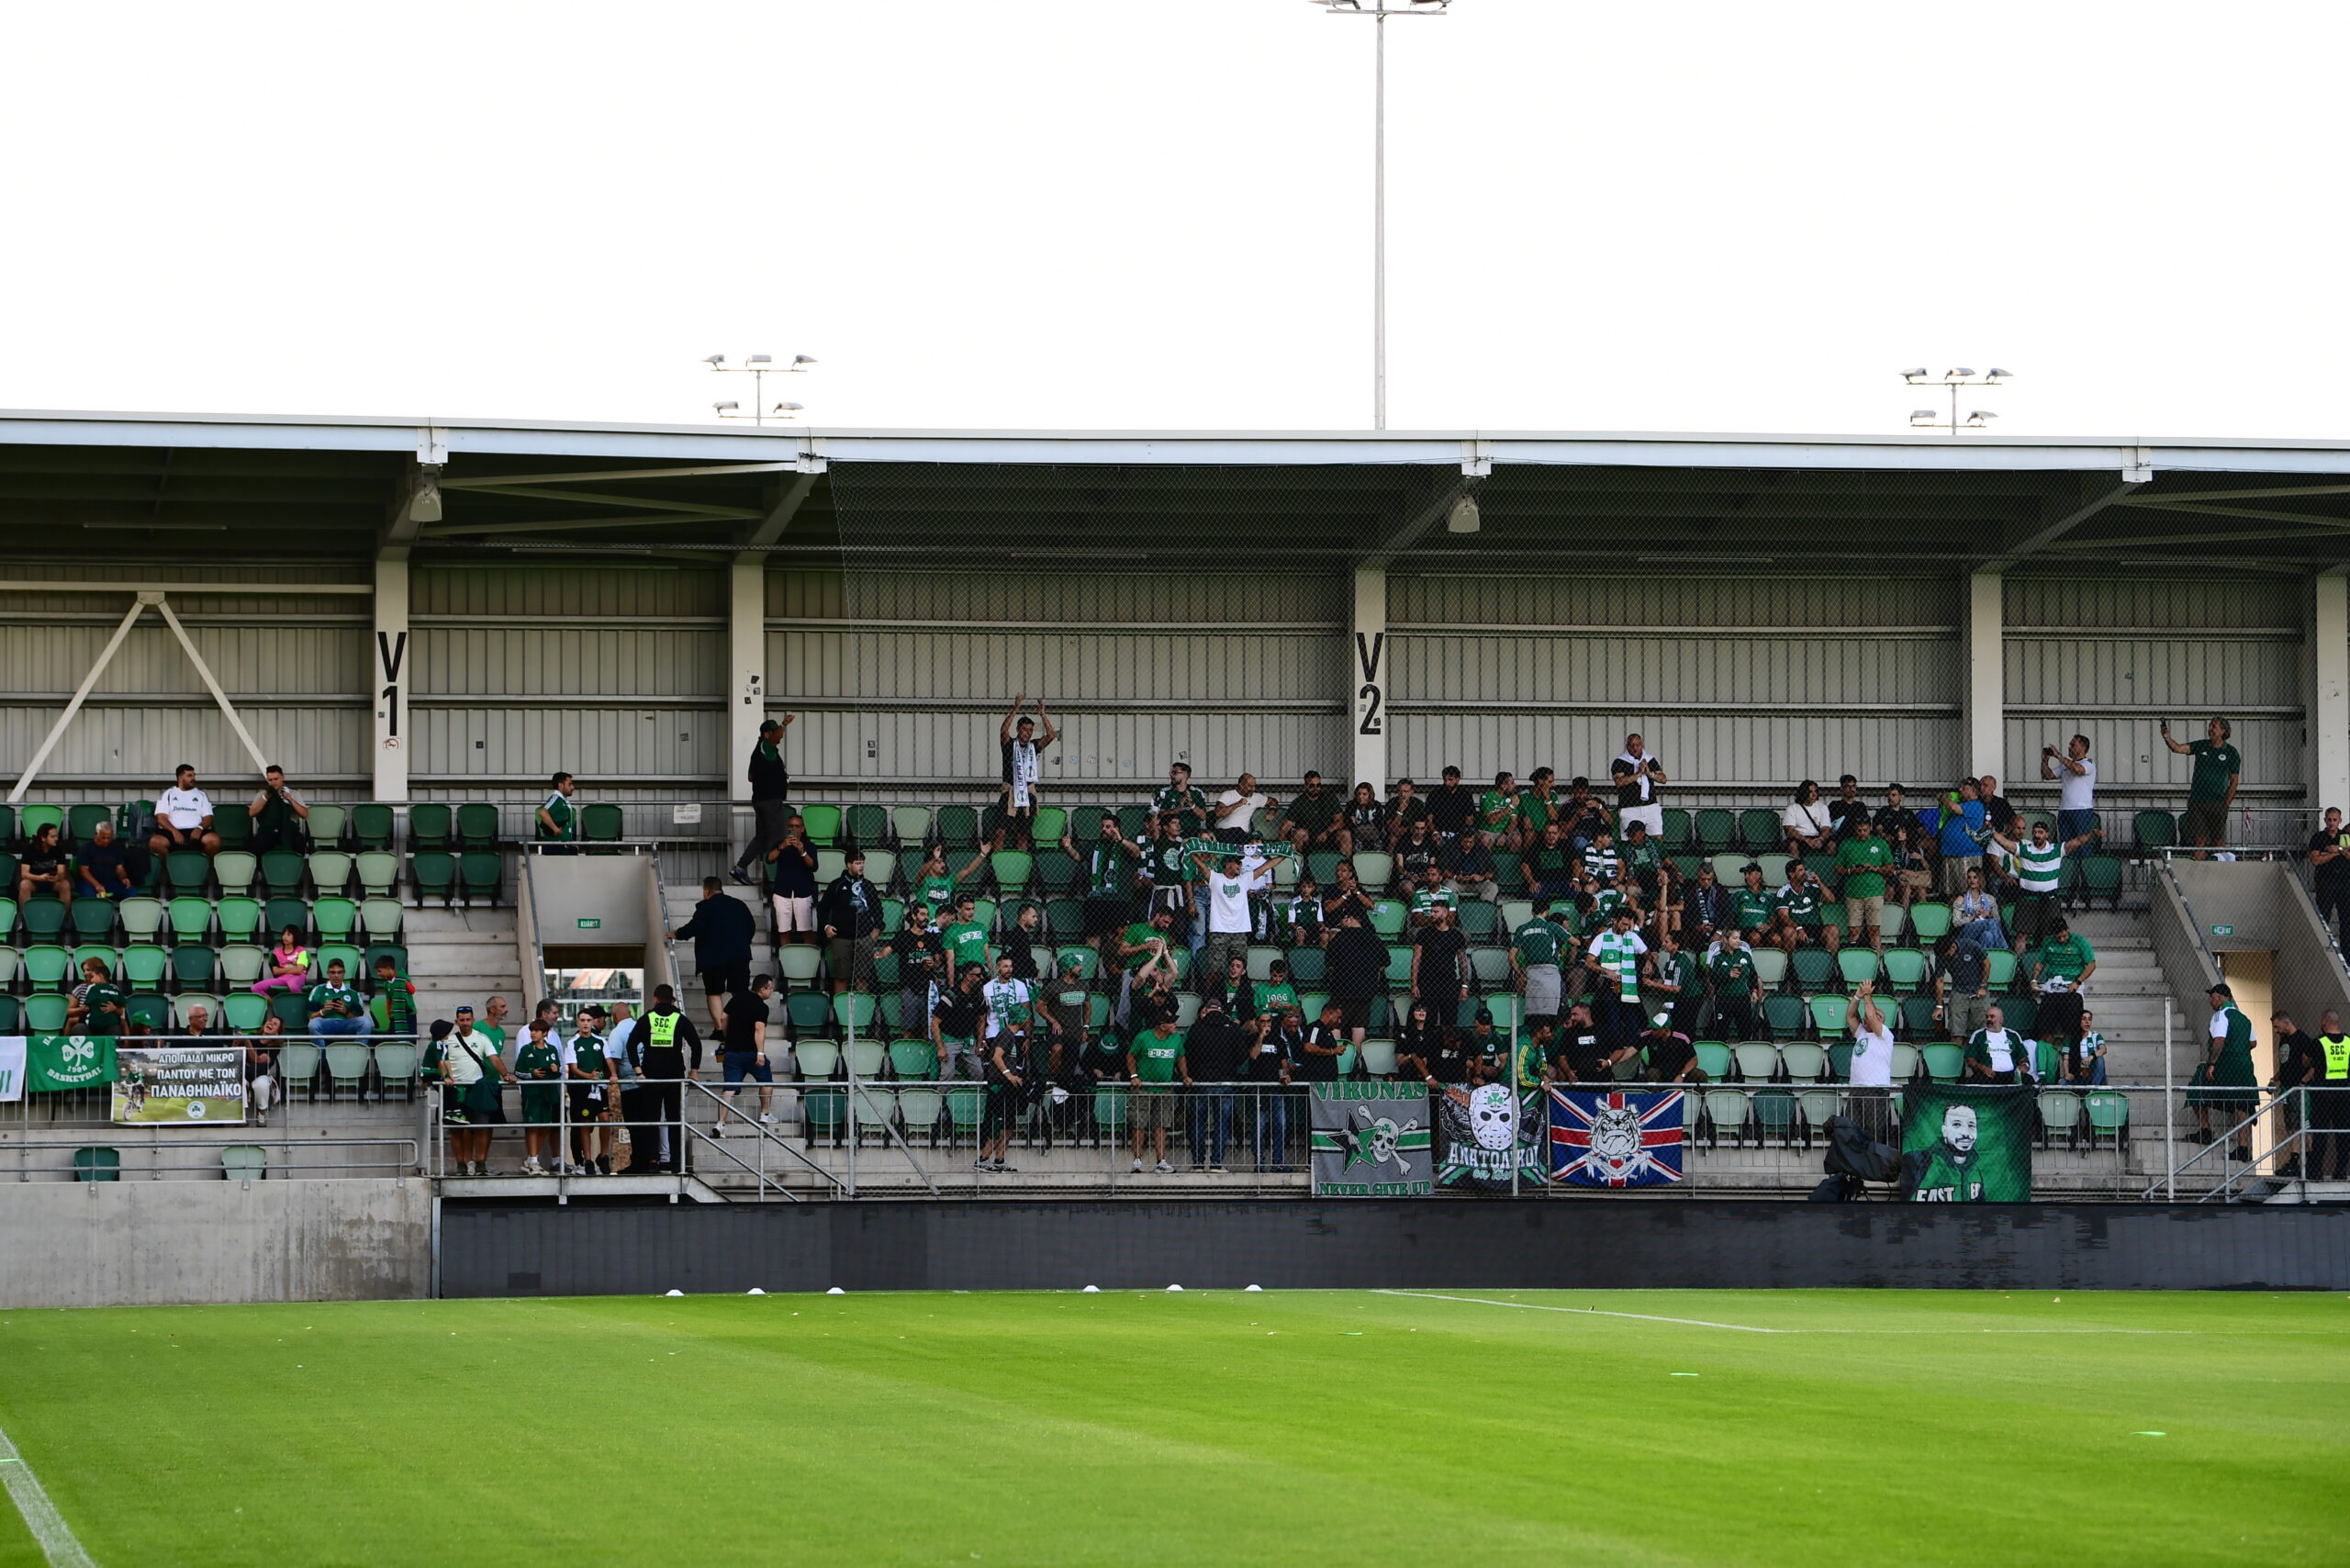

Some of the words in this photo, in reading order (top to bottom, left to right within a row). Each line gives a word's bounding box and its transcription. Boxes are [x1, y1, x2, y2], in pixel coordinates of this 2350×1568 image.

[654, 1017, 671, 1029] SEC.
[158, 1054, 179, 1064] ΑΠΟ
[180, 1053, 204, 1063] ΠΑΙΔΙ
[206, 1052, 235, 1063] ΜΙΚΡΟ
[2330, 1045, 2347, 1056] SEC.
[46, 1063, 104, 1082] BASKETBAL
[157, 1069, 199, 1081] ΠΑΝΤΟΥ
[199, 1068, 214, 1079] ΜΕ
[215, 1068, 236, 1079] ΤΟΝ
[151, 1081, 241, 1098] ΠΑΝΑΘΗΝΑΪΚΟ
[1314, 1081, 1429, 1102] VIRONAS
[1448, 1142, 1539, 1170] ΑΝΑΤΟΛΚΟΙ
[1318, 1182, 1370, 1196] NEVER
[1371, 1181, 1409, 1196] GIVE
[1411, 1180, 1432, 1195] UP
